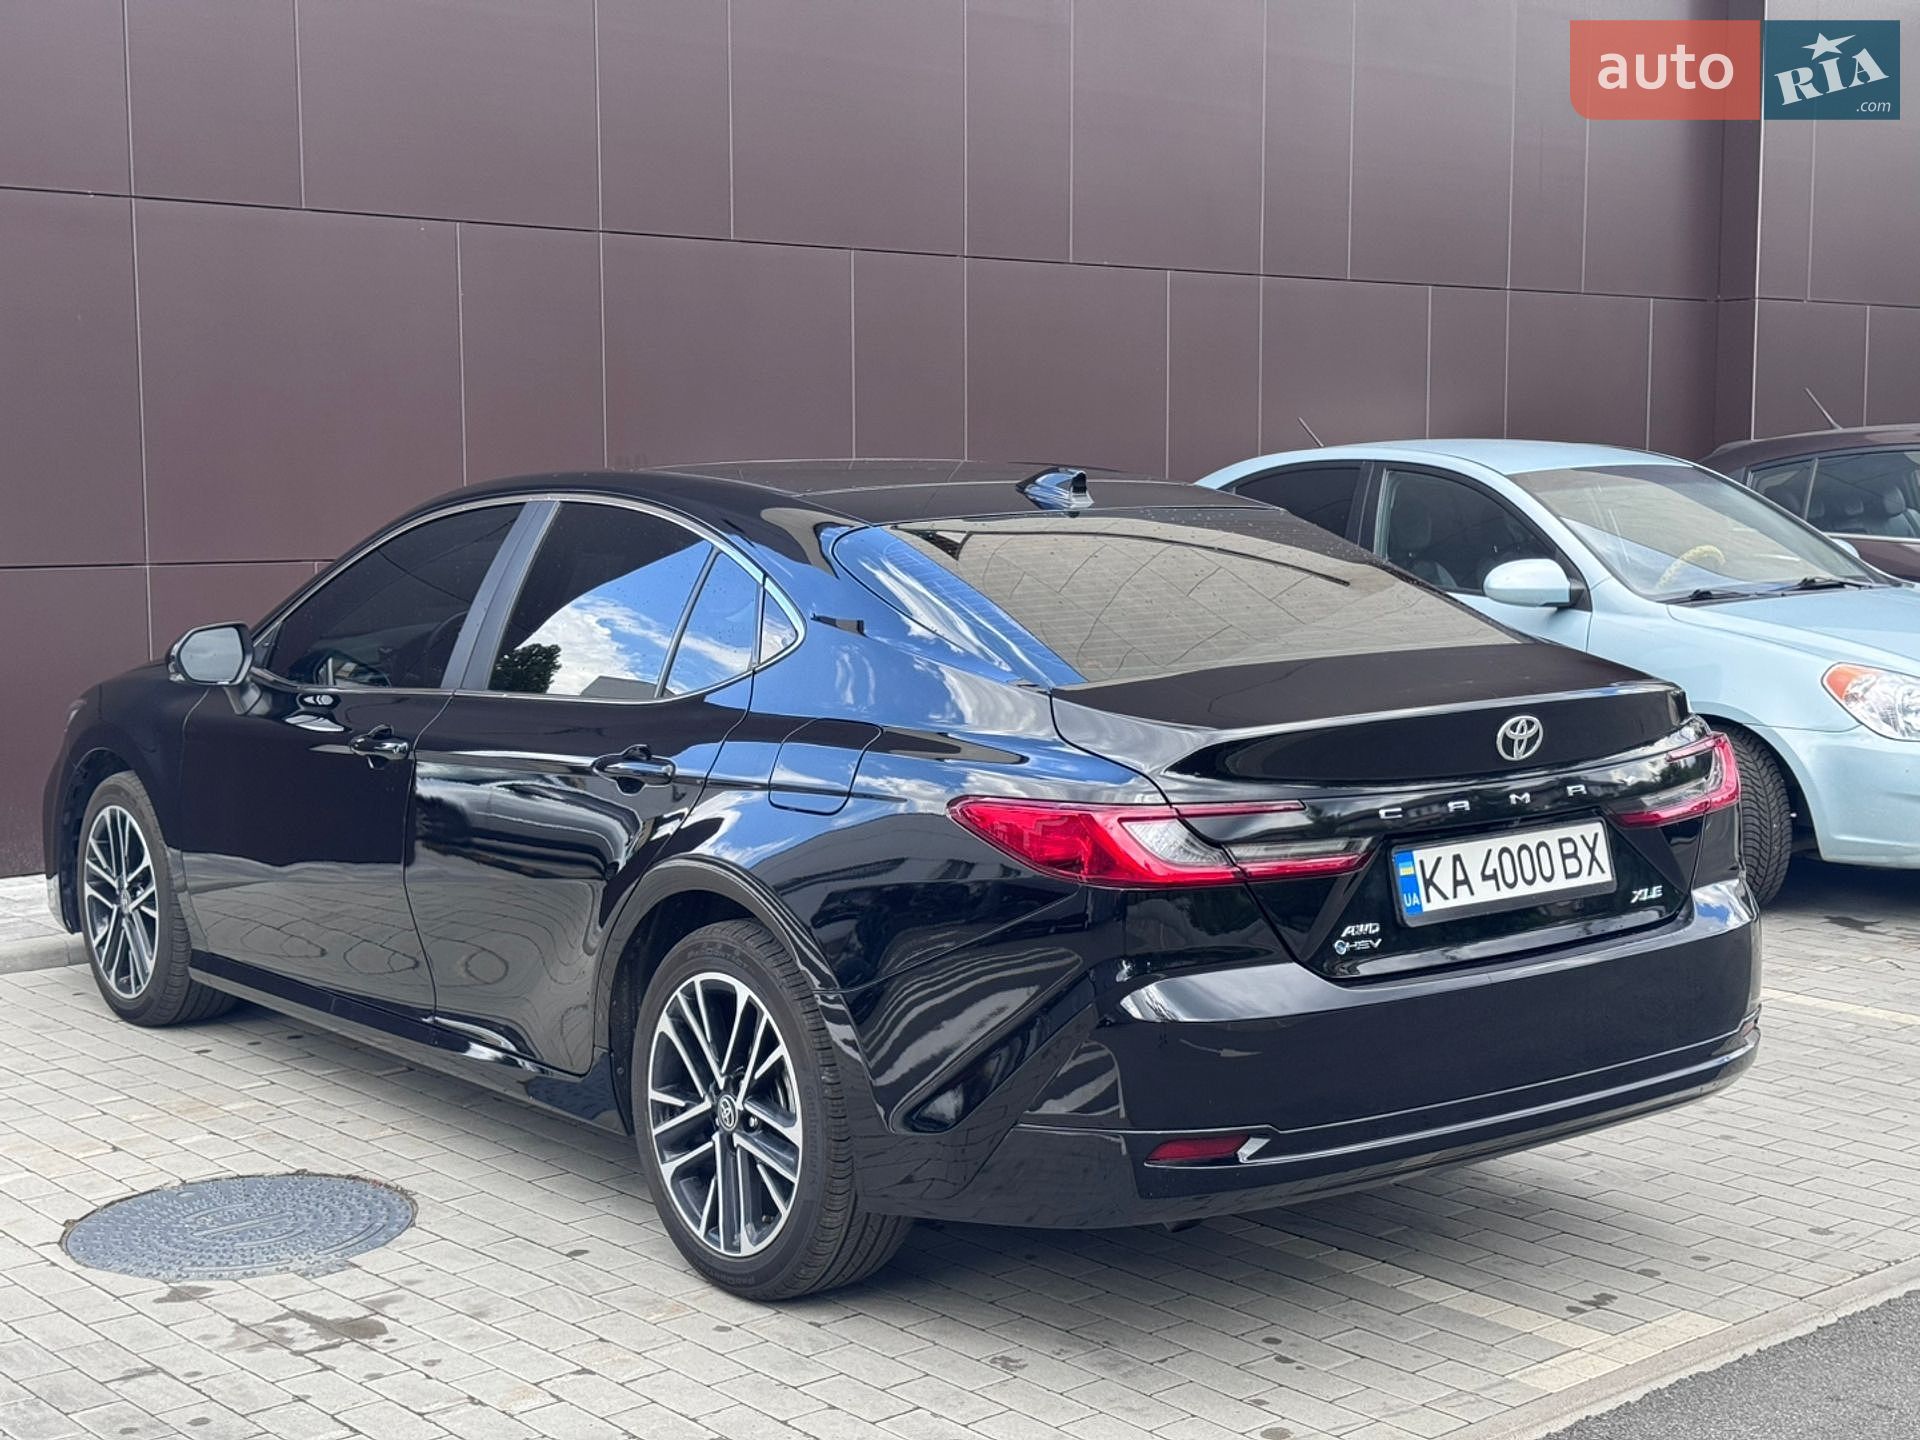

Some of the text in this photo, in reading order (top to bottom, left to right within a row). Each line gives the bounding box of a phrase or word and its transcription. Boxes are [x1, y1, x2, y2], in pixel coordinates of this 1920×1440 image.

[1420, 831, 1606, 903] KA 4000 BX
[1403, 892, 1420, 908] UA
[1630, 885, 1663, 903] XLE
[1341, 922, 1380, 937] AWD
